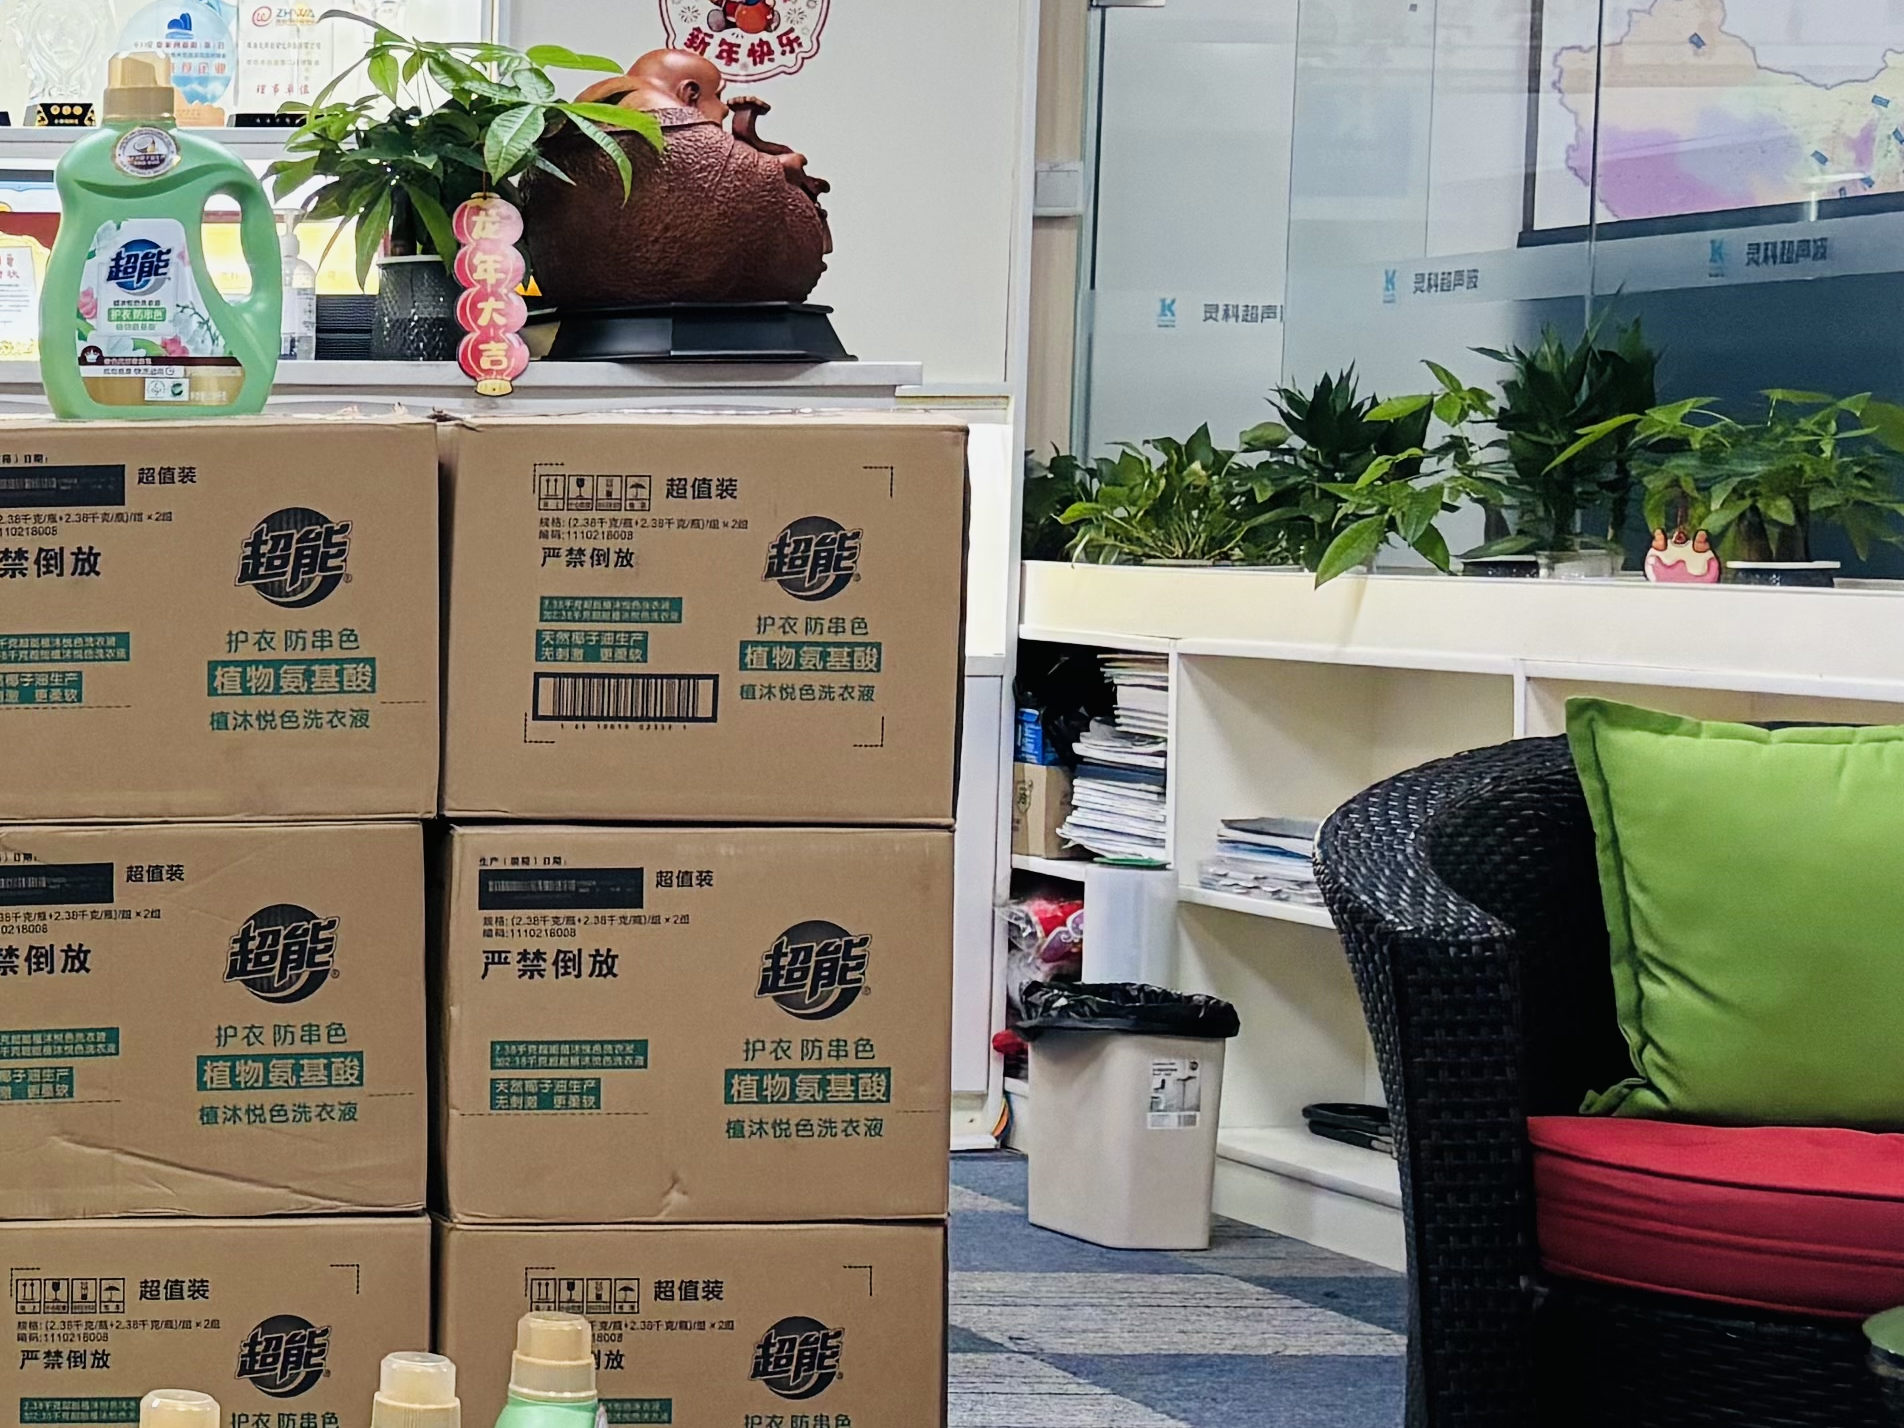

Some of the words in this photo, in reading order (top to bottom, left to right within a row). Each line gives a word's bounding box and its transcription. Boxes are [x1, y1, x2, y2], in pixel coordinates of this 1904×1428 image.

[683, 27, 804, 67] 新年快乐
[1745, 238, 1829, 268] 灵科超声波
[471, 207, 510, 370] 龙年大吉
[1412, 269, 1479, 294] 灵科超声波
[1203, 303, 1284, 325] 灵科超声
[666, 478, 738, 500] 超值装
[237, 521, 352, 589] 超能
[541, 548, 635, 569] 严禁倒放
[763, 528, 863, 585] 超能
[225, 629, 275, 653] 护衣
[284, 629, 360, 652] 防串色
[744, 645, 879, 669] 植物氨基酸
[214, 662, 374, 693] 植物氨基酸
[740, 684, 875, 702] 植沐悦色洗衣液
[210, 709, 370, 731] 植沐悦色洗衣液
[482, 948, 619, 980] 严禁倒放
[204, 1057, 361, 1088] 植物氨基酸
[731, 1073, 889, 1101] 植物氨基酸
[199, 1103, 358, 1126] 植沐悦色洗衣液
[726, 1118, 884, 1139] 植沐悦色洗衣液
[139, 1279, 210, 1301] 超值装
[654, 1279, 725, 1302] 超值装
